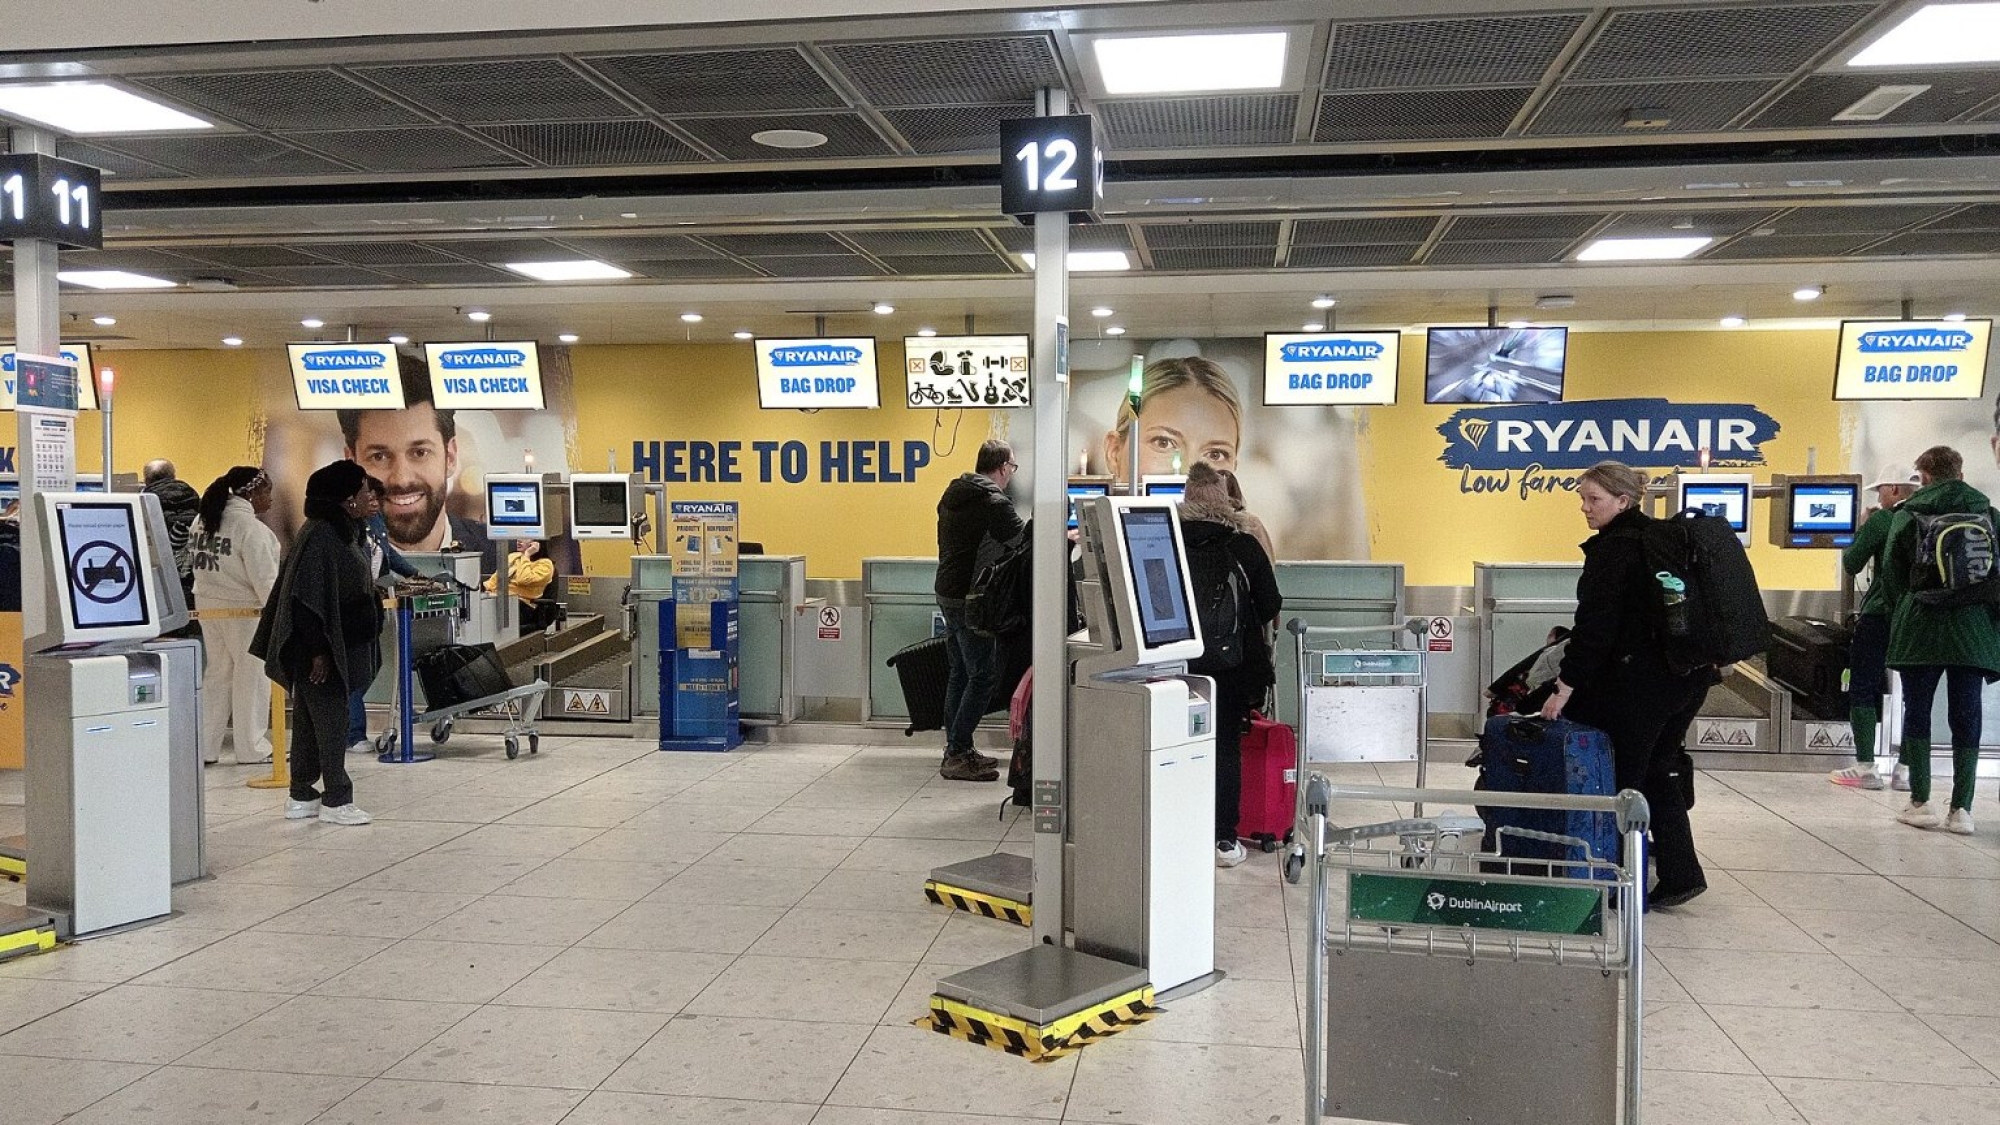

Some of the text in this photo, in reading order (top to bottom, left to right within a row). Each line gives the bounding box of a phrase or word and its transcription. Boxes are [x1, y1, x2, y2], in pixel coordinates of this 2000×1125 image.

[1016, 138, 1078, 191] 12
[51, 179, 90, 229] 11
[1876, 335, 1967, 347] RYANAIR
[455, 353, 522, 365] RYANAIR
[784, 350, 858, 362] RYANAIR
[1297, 345, 1378, 357] RYANAIR
[317, 355, 382, 366] RYANAIR
[1288, 373, 1373, 390] BAG DROP
[1864, 365, 1958, 382] BAG DROP
[307, 378, 390, 394] VISA CHECK
[443, 377, 529, 393] VISA CHECK
[780, 377, 856, 394] BAG DROP
[1496, 418, 1757, 452] RYANAIR
[633, 439, 931, 483] HERE TO HELP
[1460, 463, 1510, 495] Low
[682, 503, 734, 513] RYANAIR
[1448, 896, 1523, 914] DublinAirport
